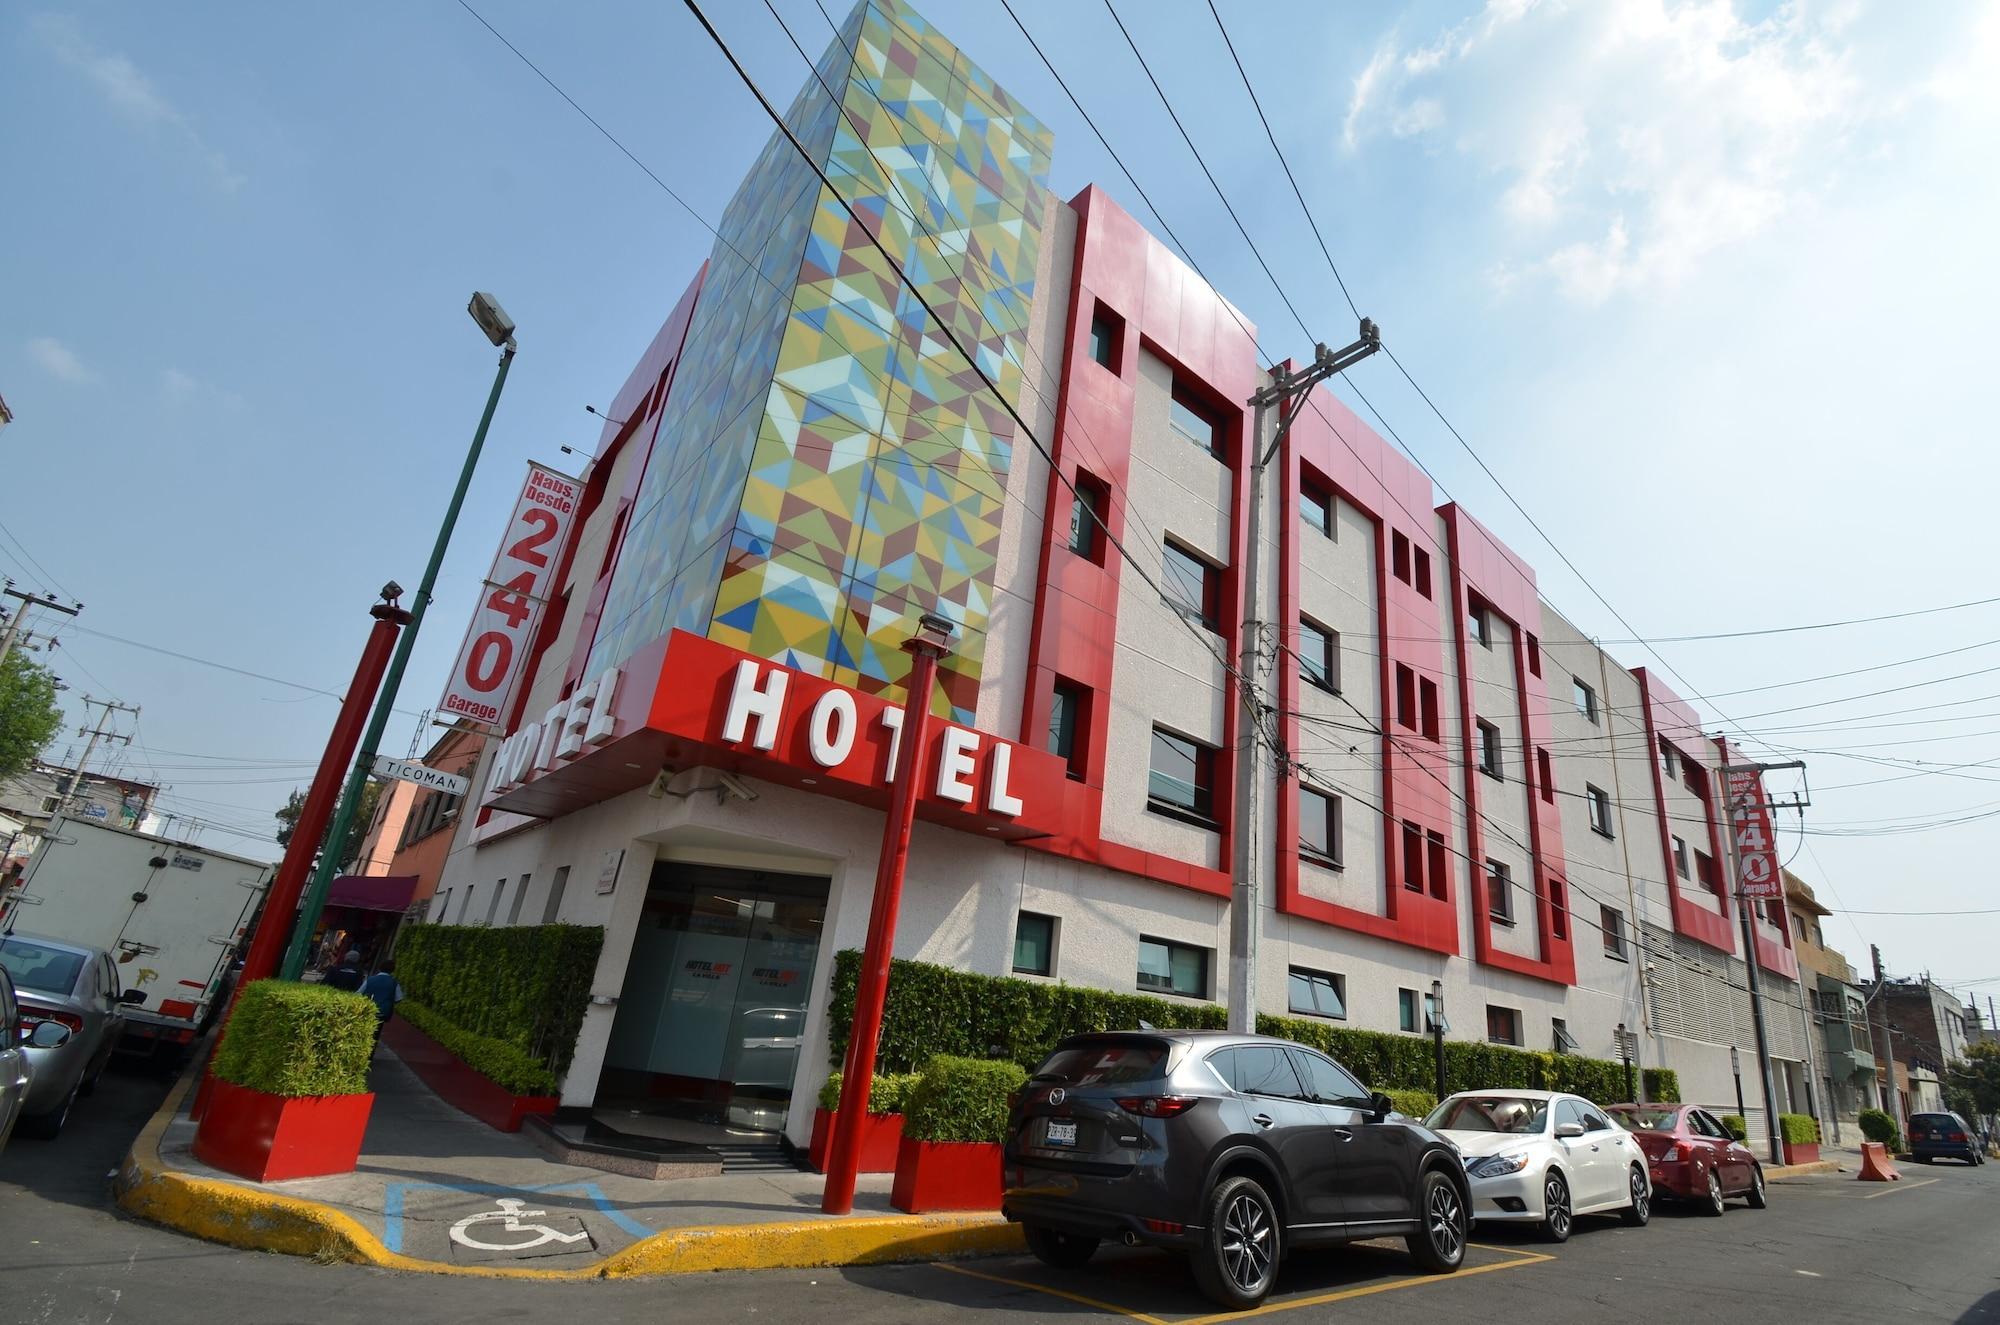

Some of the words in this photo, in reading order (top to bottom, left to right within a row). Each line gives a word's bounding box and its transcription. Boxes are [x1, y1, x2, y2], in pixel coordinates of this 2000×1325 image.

[531, 470, 574, 499] Habs.
[525, 485, 571, 514] Desde
[446, 694, 497, 720] Garage
[490, 667, 620, 792] HOTEL
[387, 761, 457, 789] TICOMAN
